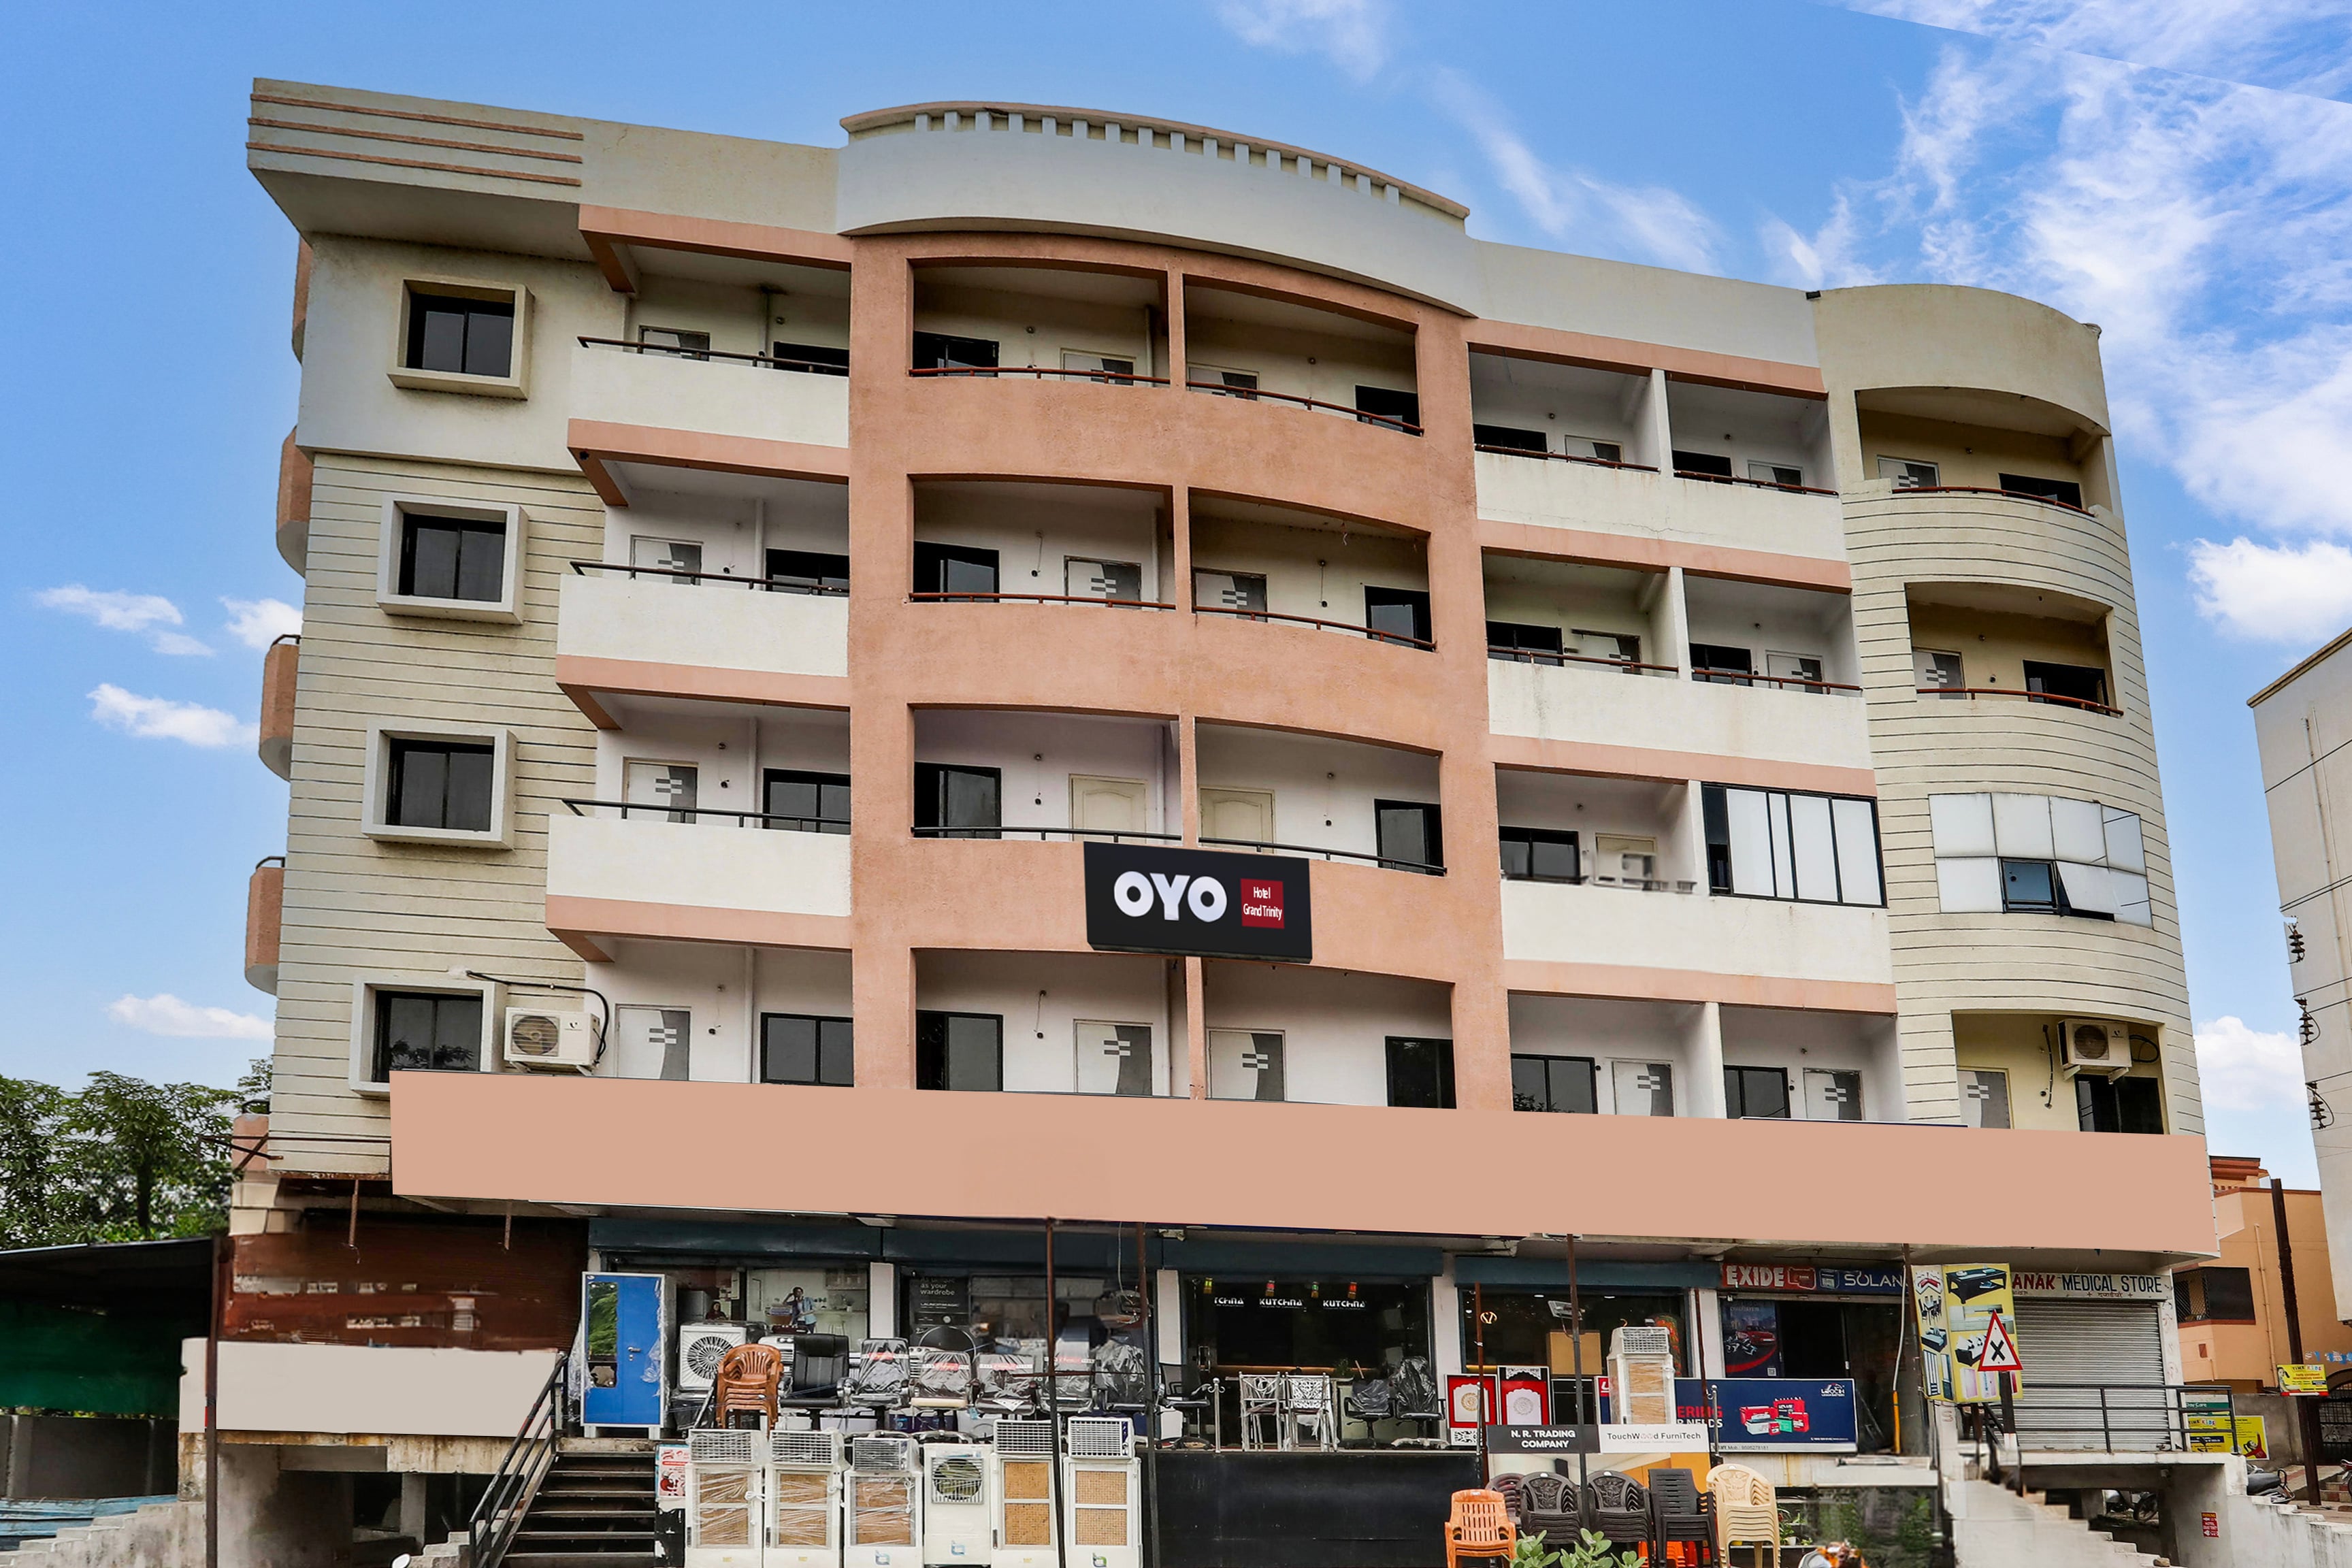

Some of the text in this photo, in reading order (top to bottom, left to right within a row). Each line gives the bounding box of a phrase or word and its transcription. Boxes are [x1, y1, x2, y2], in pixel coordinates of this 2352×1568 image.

[1114, 871, 1227, 922] OYO
[1253, 886, 1271, 899] Hotel
[1243, 903, 1283, 921] Grand Trinity
[1726, 1265, 1784, 1288] EXIDE
[2061, 1274, 2117, 1292] MEDICAL
[2121, 1275, 2163, 1293] STORE
[1511, 1430, 1576, 1438] N. R. TRADING
